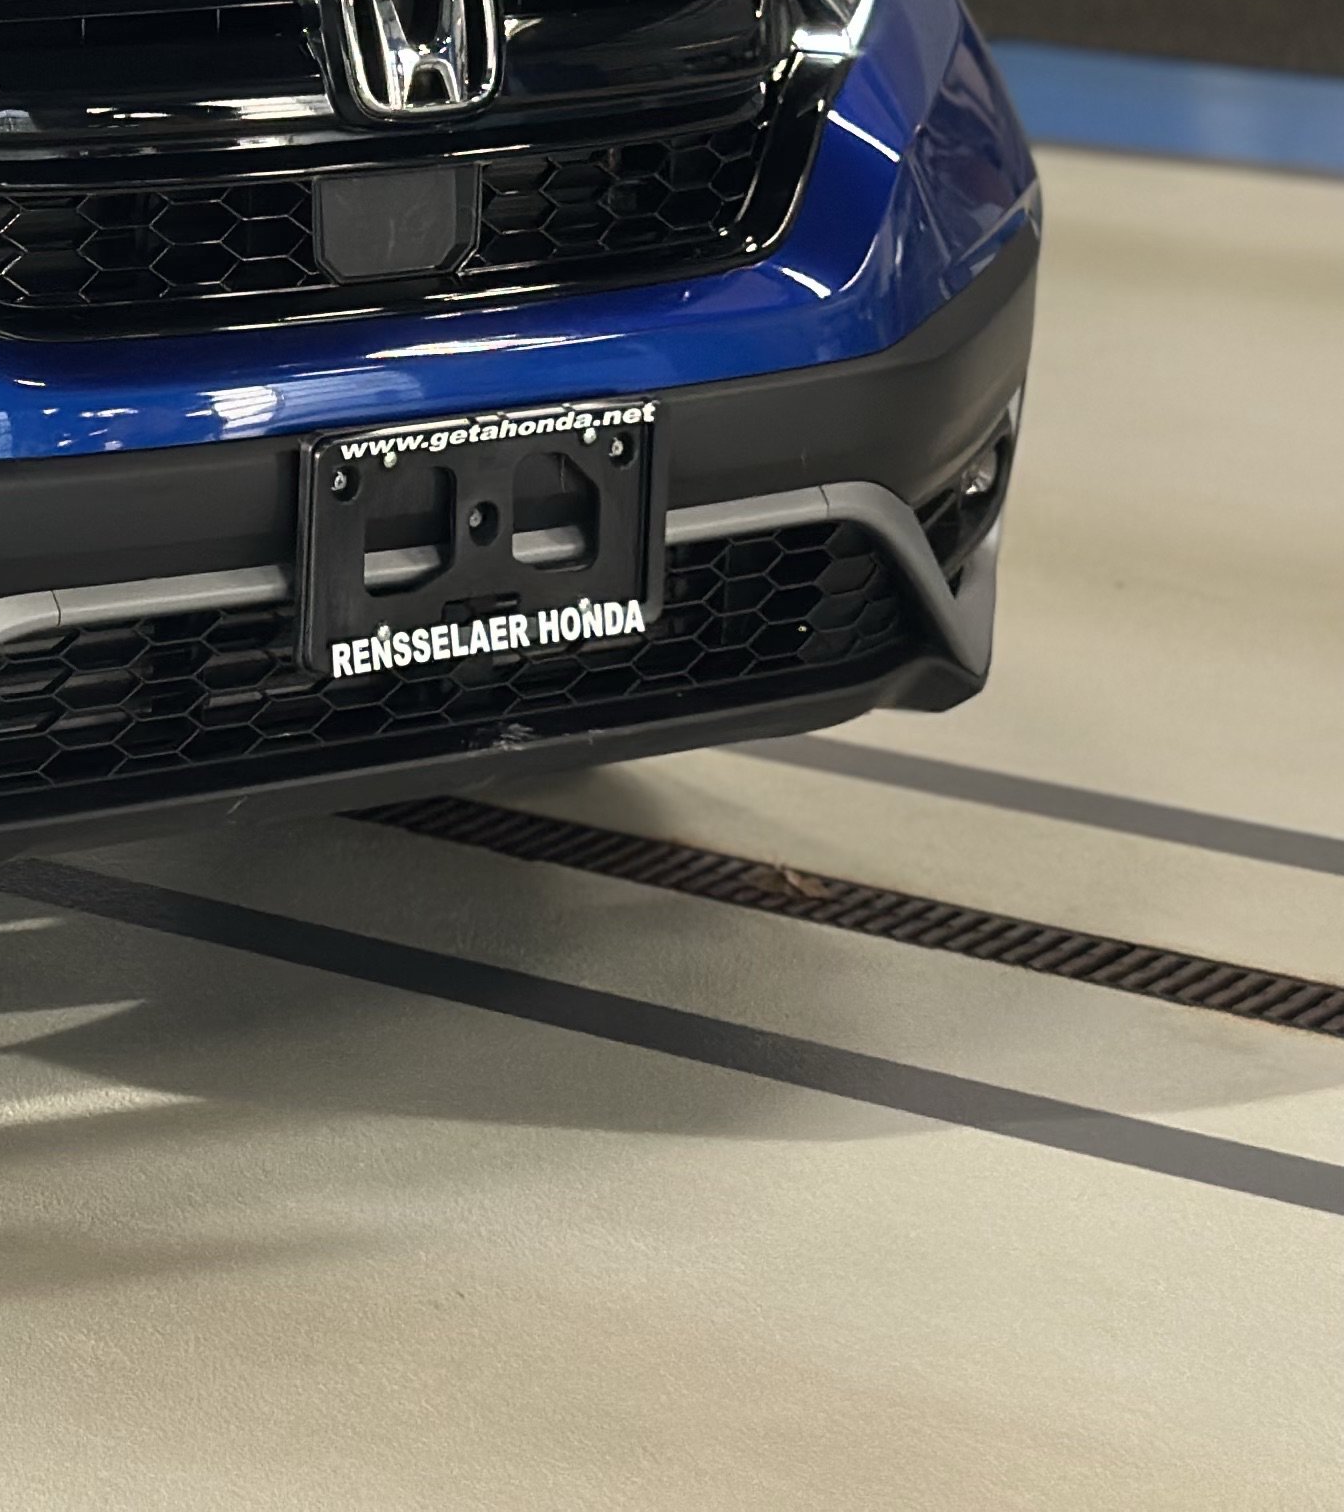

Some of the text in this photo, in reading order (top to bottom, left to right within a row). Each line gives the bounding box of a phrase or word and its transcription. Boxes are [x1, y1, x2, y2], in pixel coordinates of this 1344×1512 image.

[340, 401, 656, 460] www.getahonda.net
[331, 598, 646, 678] RENSSELAER HONDA
